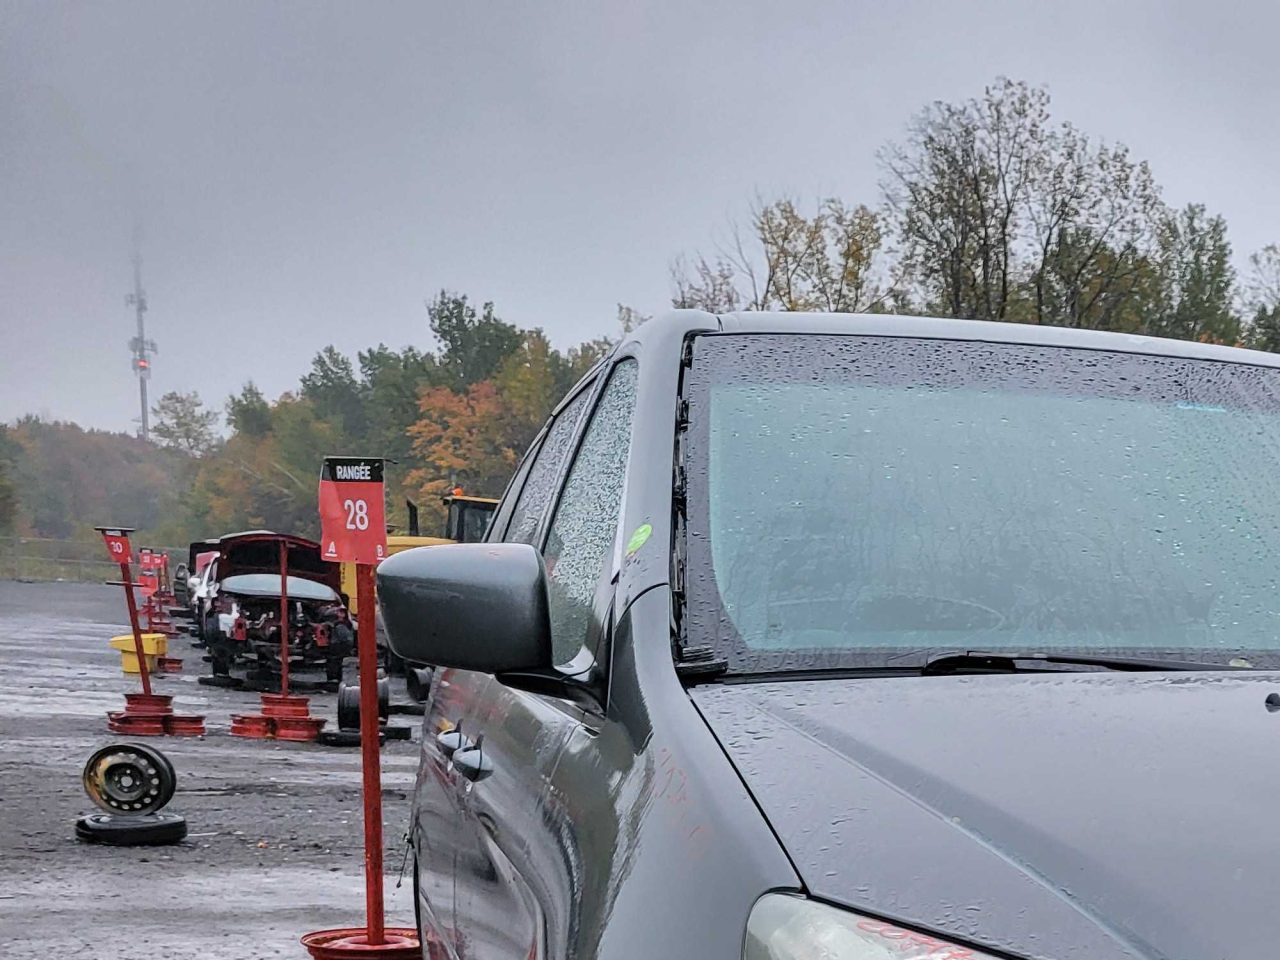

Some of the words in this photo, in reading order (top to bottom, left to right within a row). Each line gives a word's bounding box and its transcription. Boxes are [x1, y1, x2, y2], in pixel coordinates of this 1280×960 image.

[336, 462, 370, 480] RANGÉE
[344, 499, 369, 530] 28
[328, 541, 336, 553] A
[376, 544, 383, 556] B
